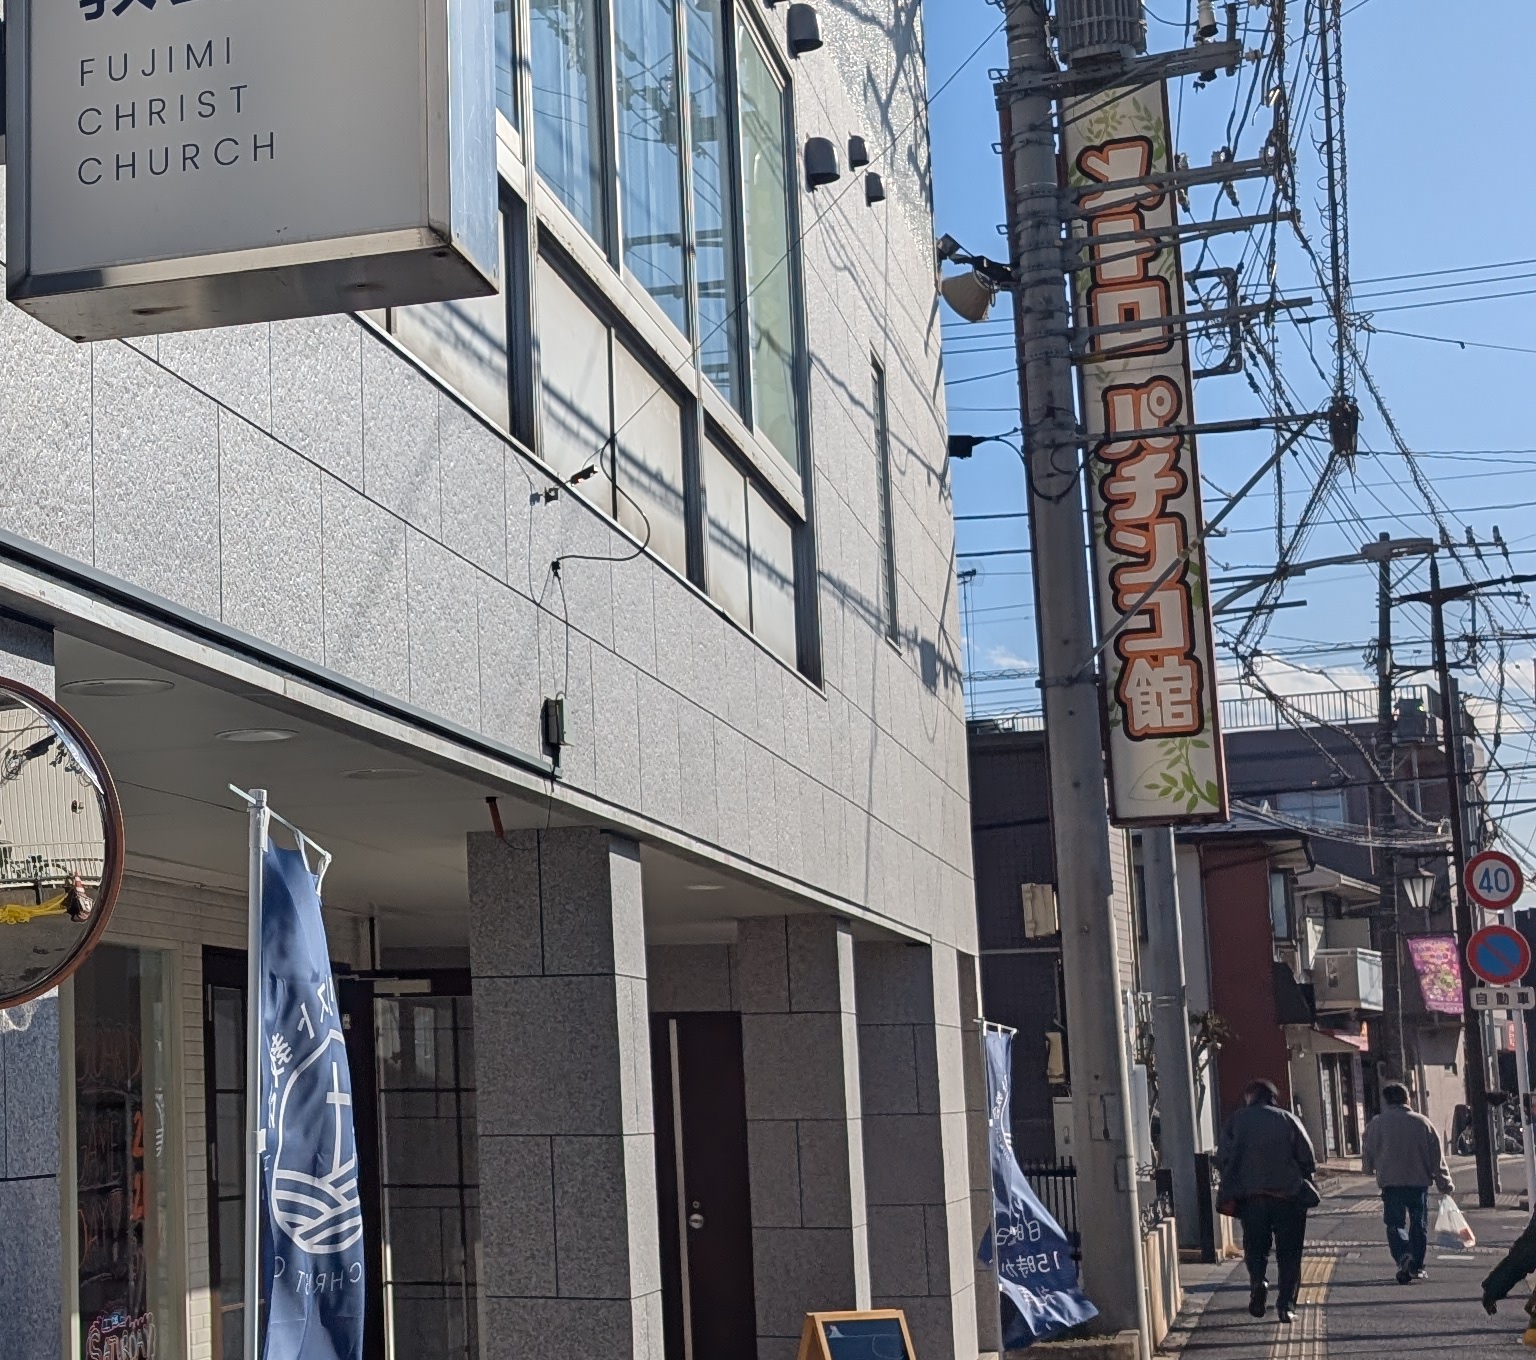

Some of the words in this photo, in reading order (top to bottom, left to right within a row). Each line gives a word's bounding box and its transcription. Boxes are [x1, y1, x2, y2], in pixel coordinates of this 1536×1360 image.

[80, 36, 230, 87] FUJIMI
[77, 84, 248, 136] CHRIST
[77, 131, 274, 186] CHURCH
[1478, 867, 1510, 893] 40
[1476, 992, 1530, 1005] 自動車
